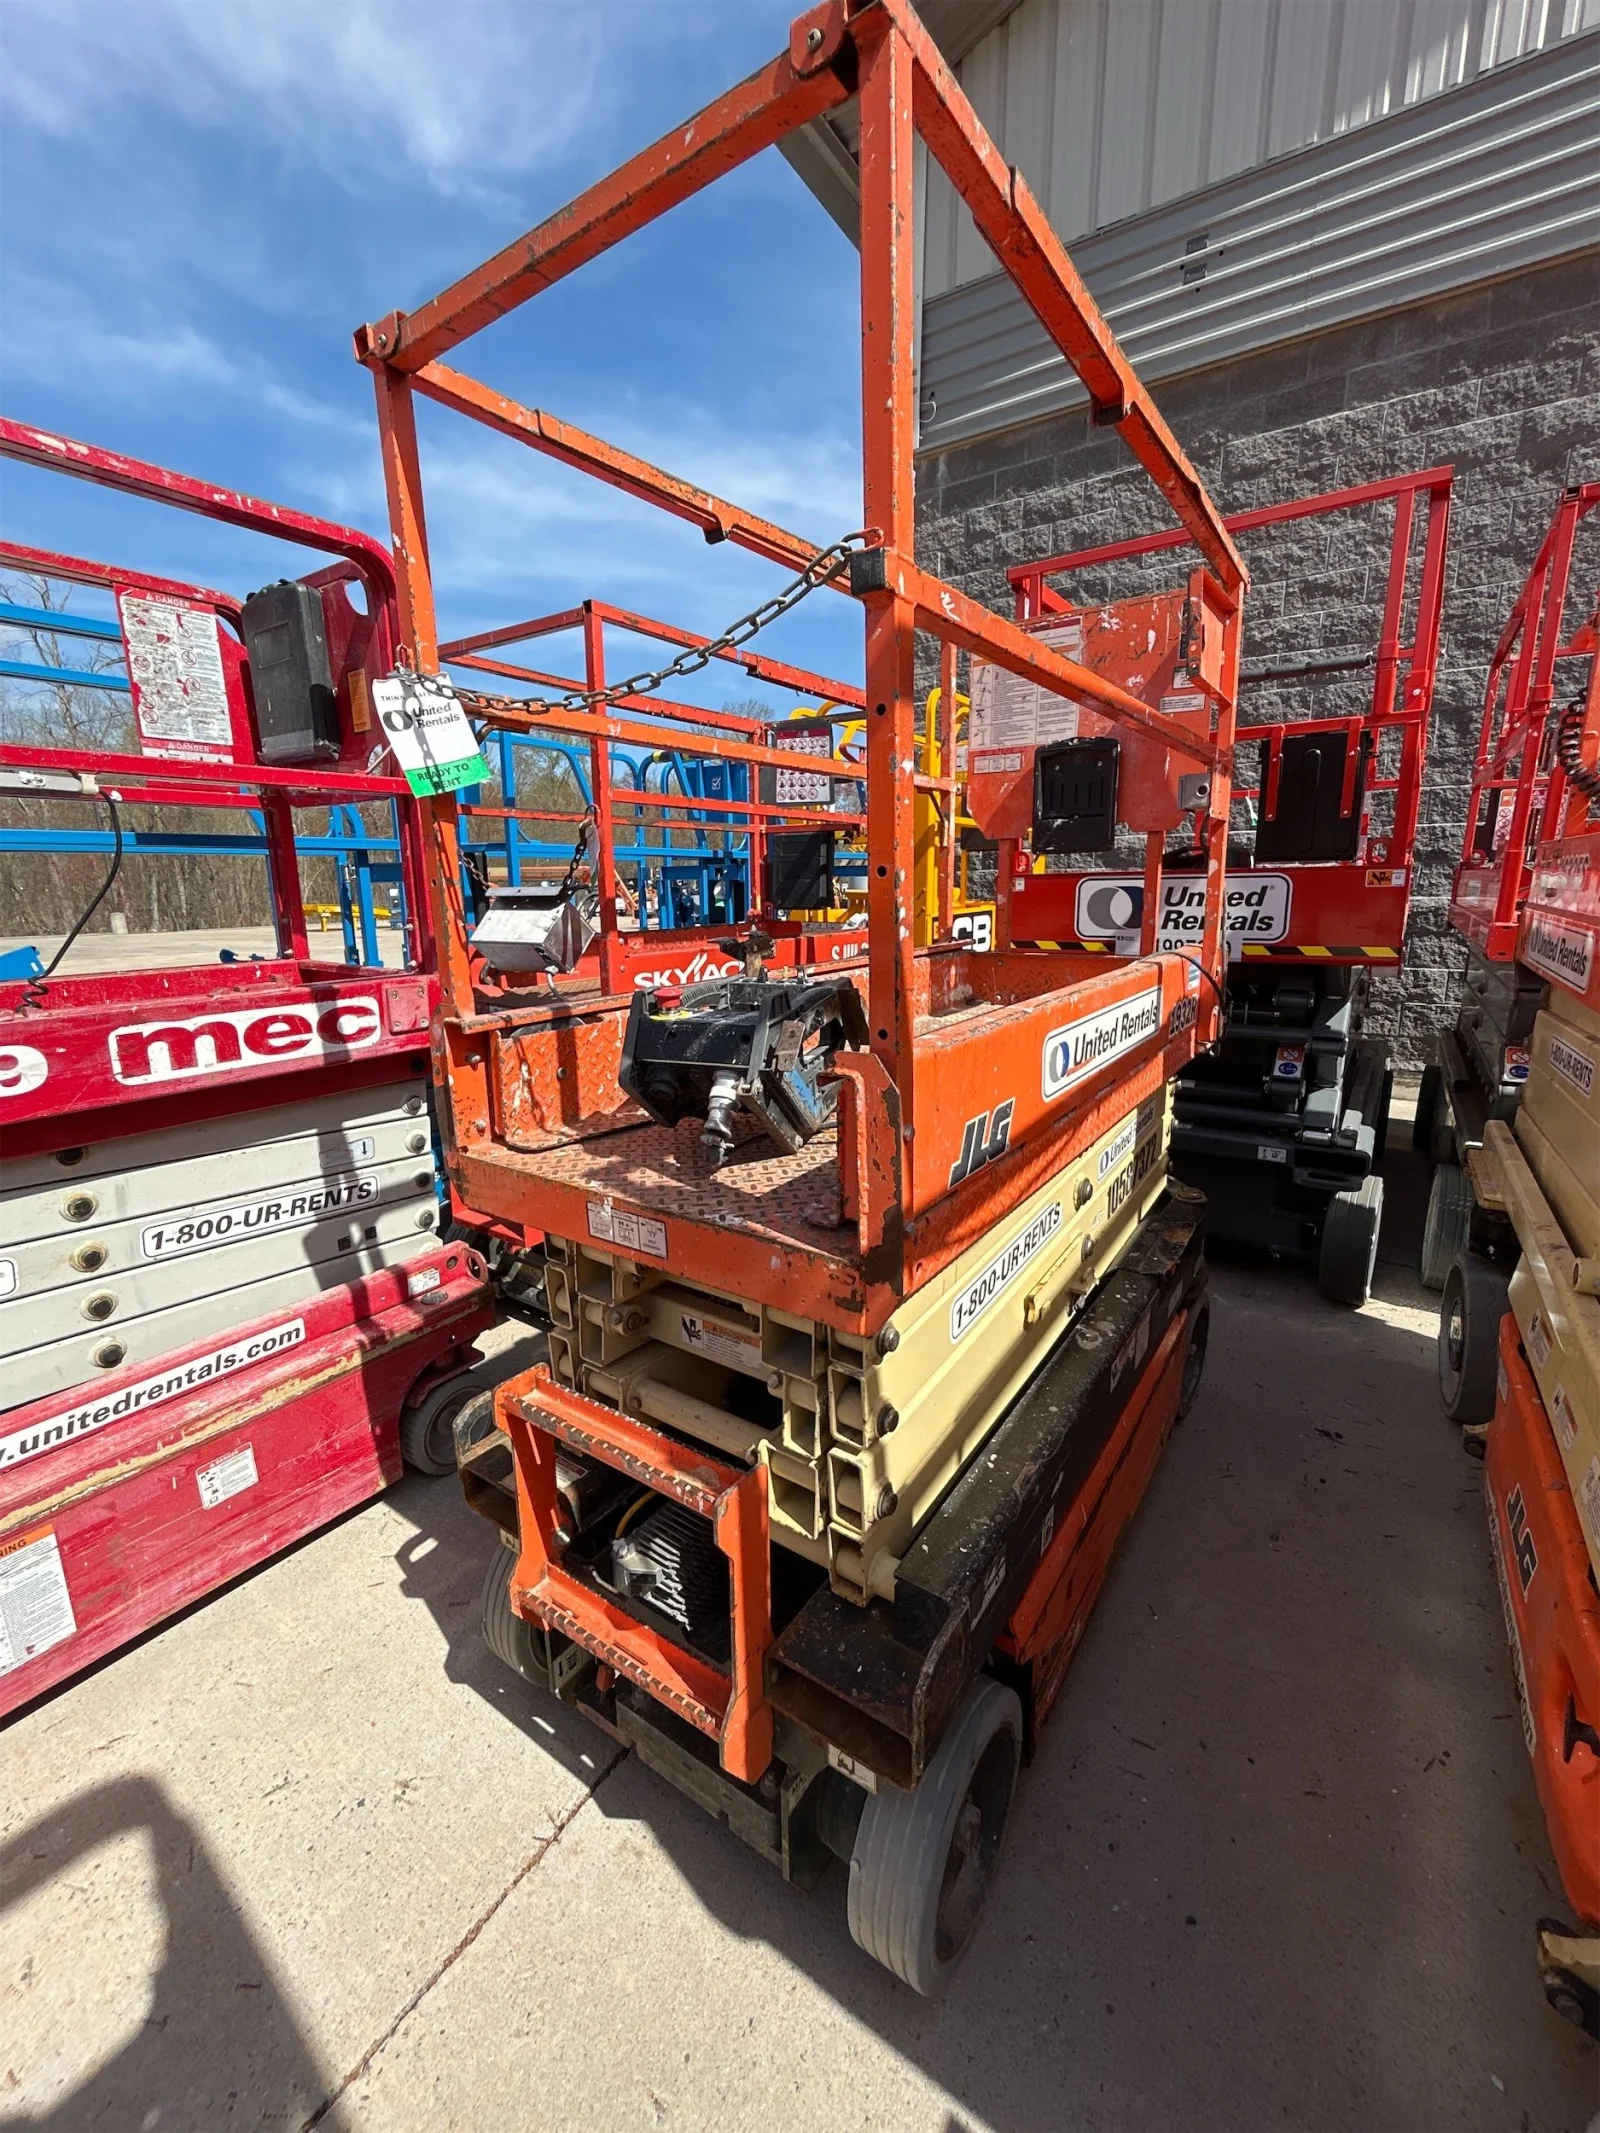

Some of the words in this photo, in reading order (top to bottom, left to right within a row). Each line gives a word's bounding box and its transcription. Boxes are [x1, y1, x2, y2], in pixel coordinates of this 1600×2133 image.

[155, 594, 191, 609] DANGER
[412, 702, 452, 718] United
[416, 713, 461, 729] Rentals
[416, 766, 452, 781] READY
[454, 762, 469, 773] TO
[434, 777, 463, 792] RENT
[1164, 885, 1269, 907] Uned
[951, 914, 991, 952] CB
[1161, 909, 1275, 931] Reals
[633, 952, 746, 988] SKYJAC
[1557, 938, 1588, 976] Rentals
[115, 1004, 378, 1079] mec
[1073, 1017, 1119, 1067] United
[1120, 999, 1158, 1042] Rentals
[948, 1097, 1015, 1190] JLG
[1110, 1125, 1133, 1163] United
[150, 1181, 373, 1251] 1-800-UR-RENTS
[956, 1202, 1061, 1329] 1-800-UR-RENTS
